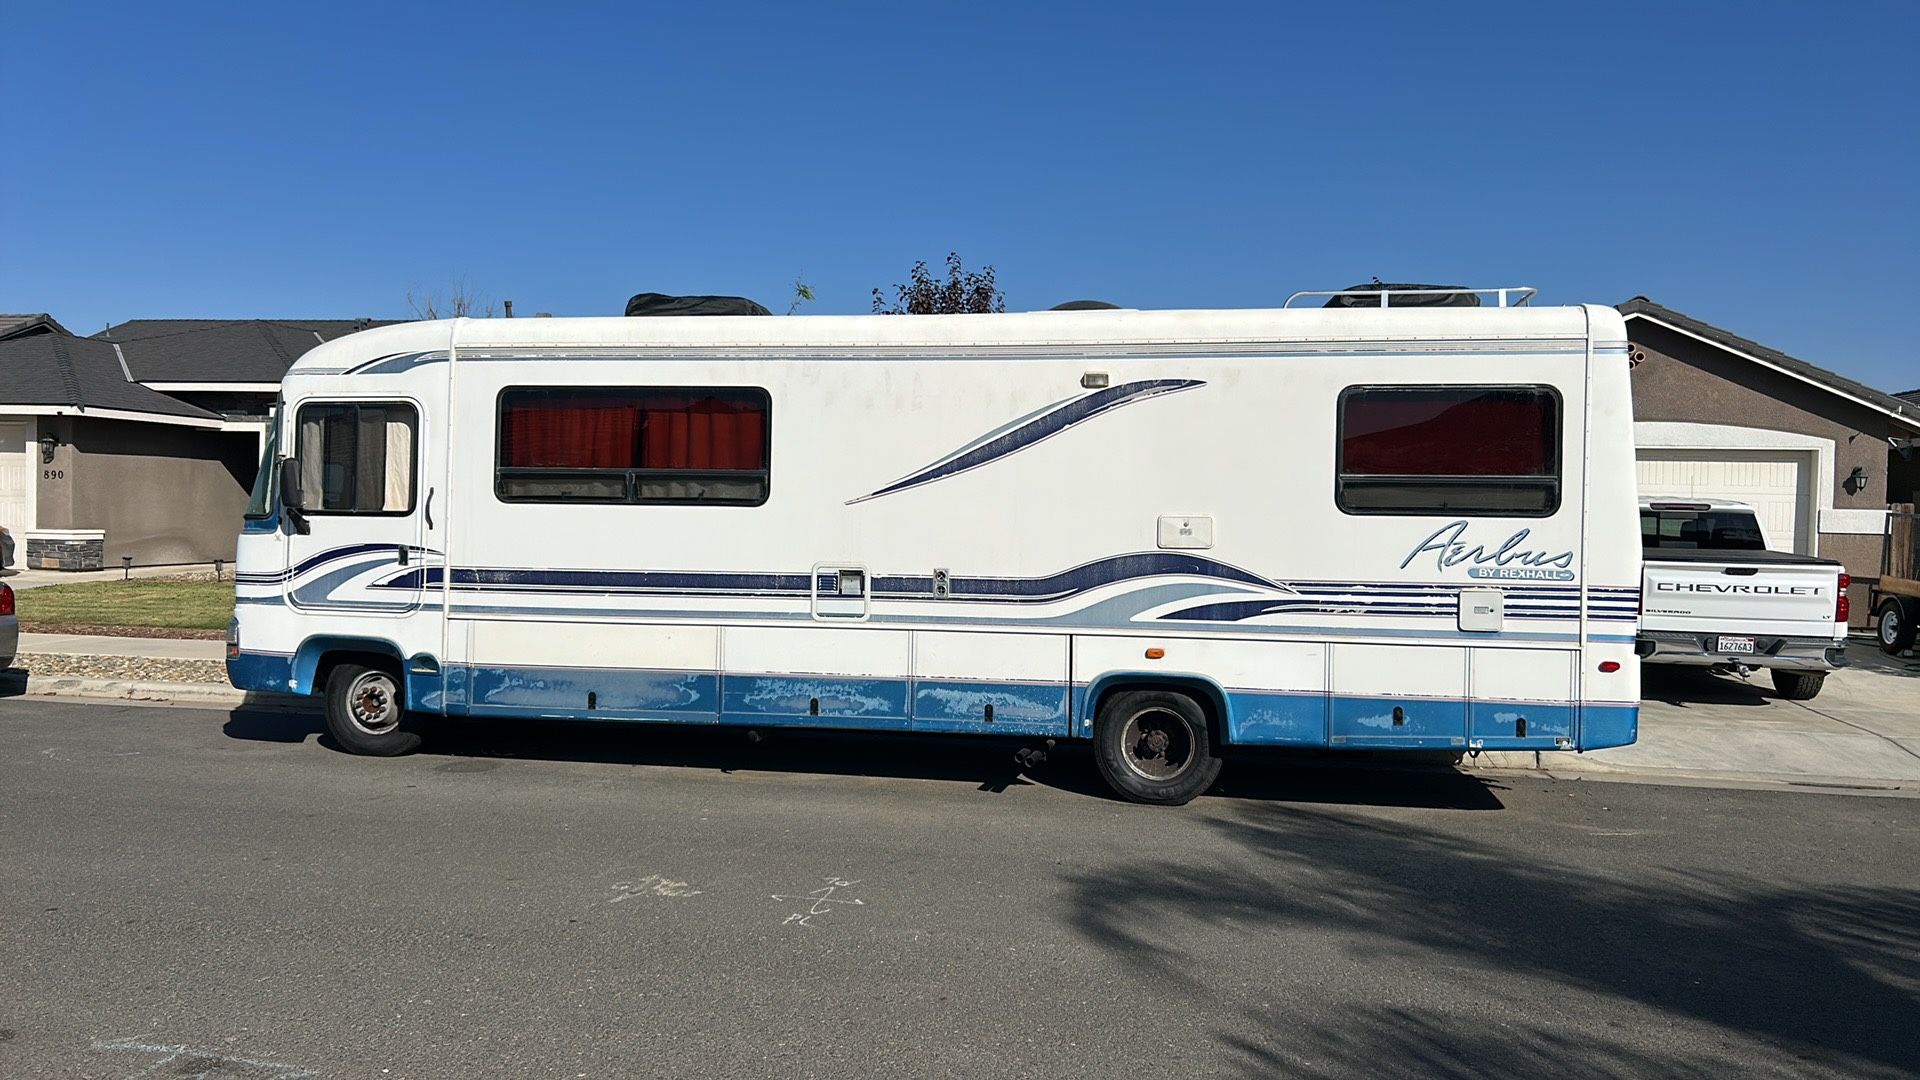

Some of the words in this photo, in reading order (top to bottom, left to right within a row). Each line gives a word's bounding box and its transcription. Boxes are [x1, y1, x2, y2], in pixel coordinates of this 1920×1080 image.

[43, 470, 64, 479] 890
[1479, 568, 1495, 578] BY
[1500, 569, 1561, 580] REXHALL
[1657, 582, 1825, 596] CHEVROLET
